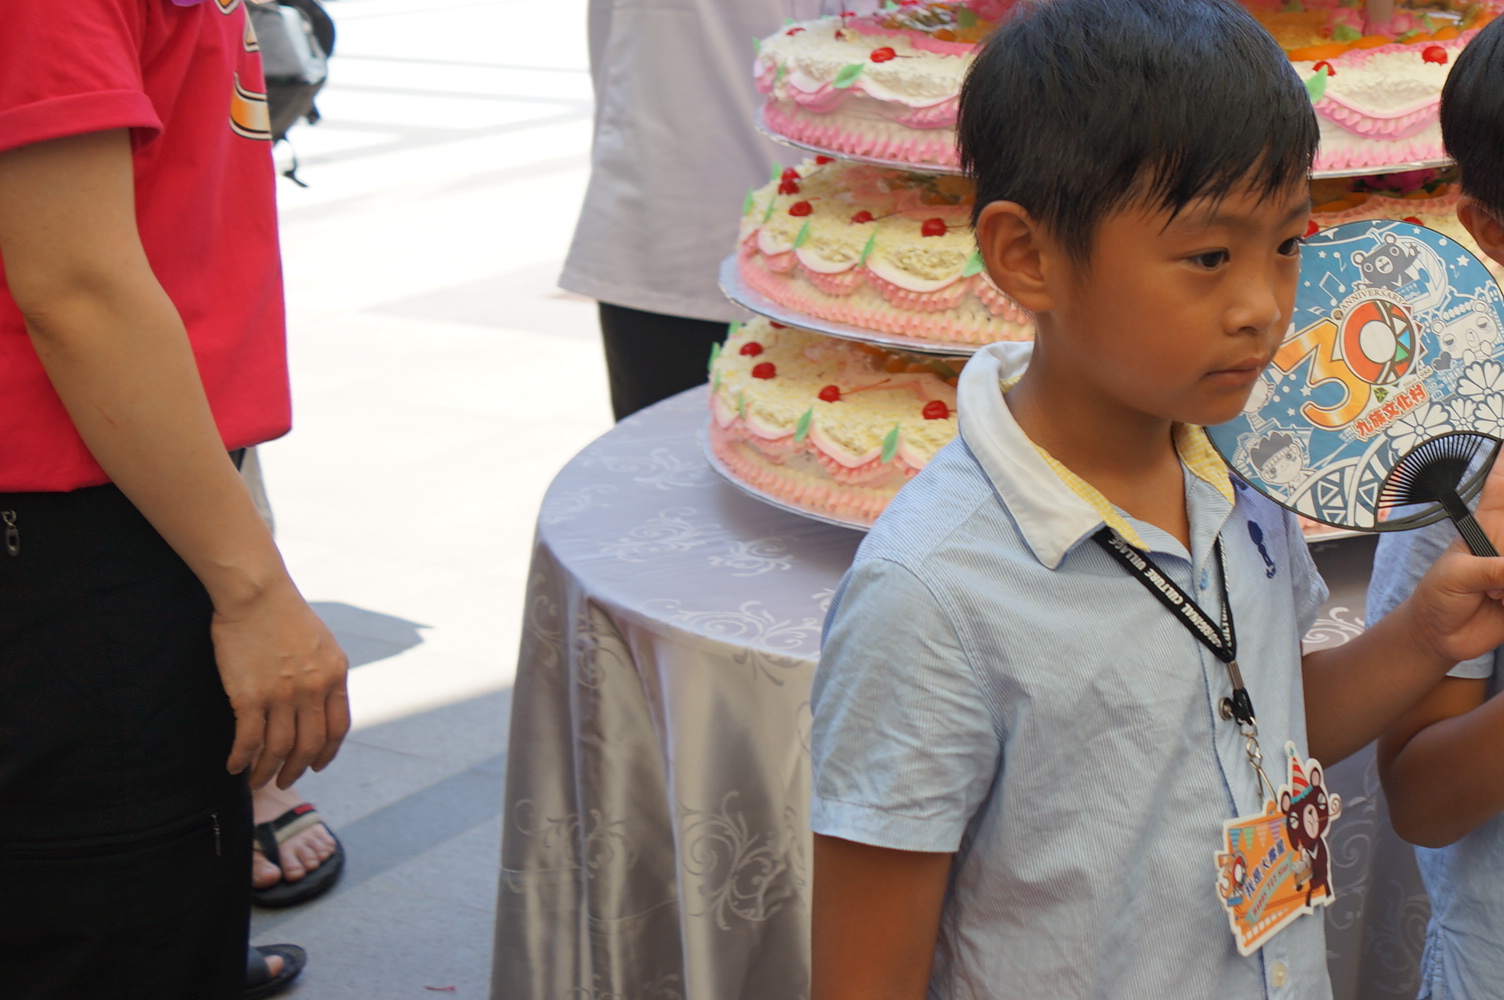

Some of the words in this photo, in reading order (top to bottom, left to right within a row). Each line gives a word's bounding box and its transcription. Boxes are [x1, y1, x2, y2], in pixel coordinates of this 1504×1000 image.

[1341, 288, 1407, 310] ANNIVERSARY
[1272, 299, 1417, 430] 30
[1355, 384, 1427, 437] 九族文化村
[1144, 568, 1183, 605] CULTURE
